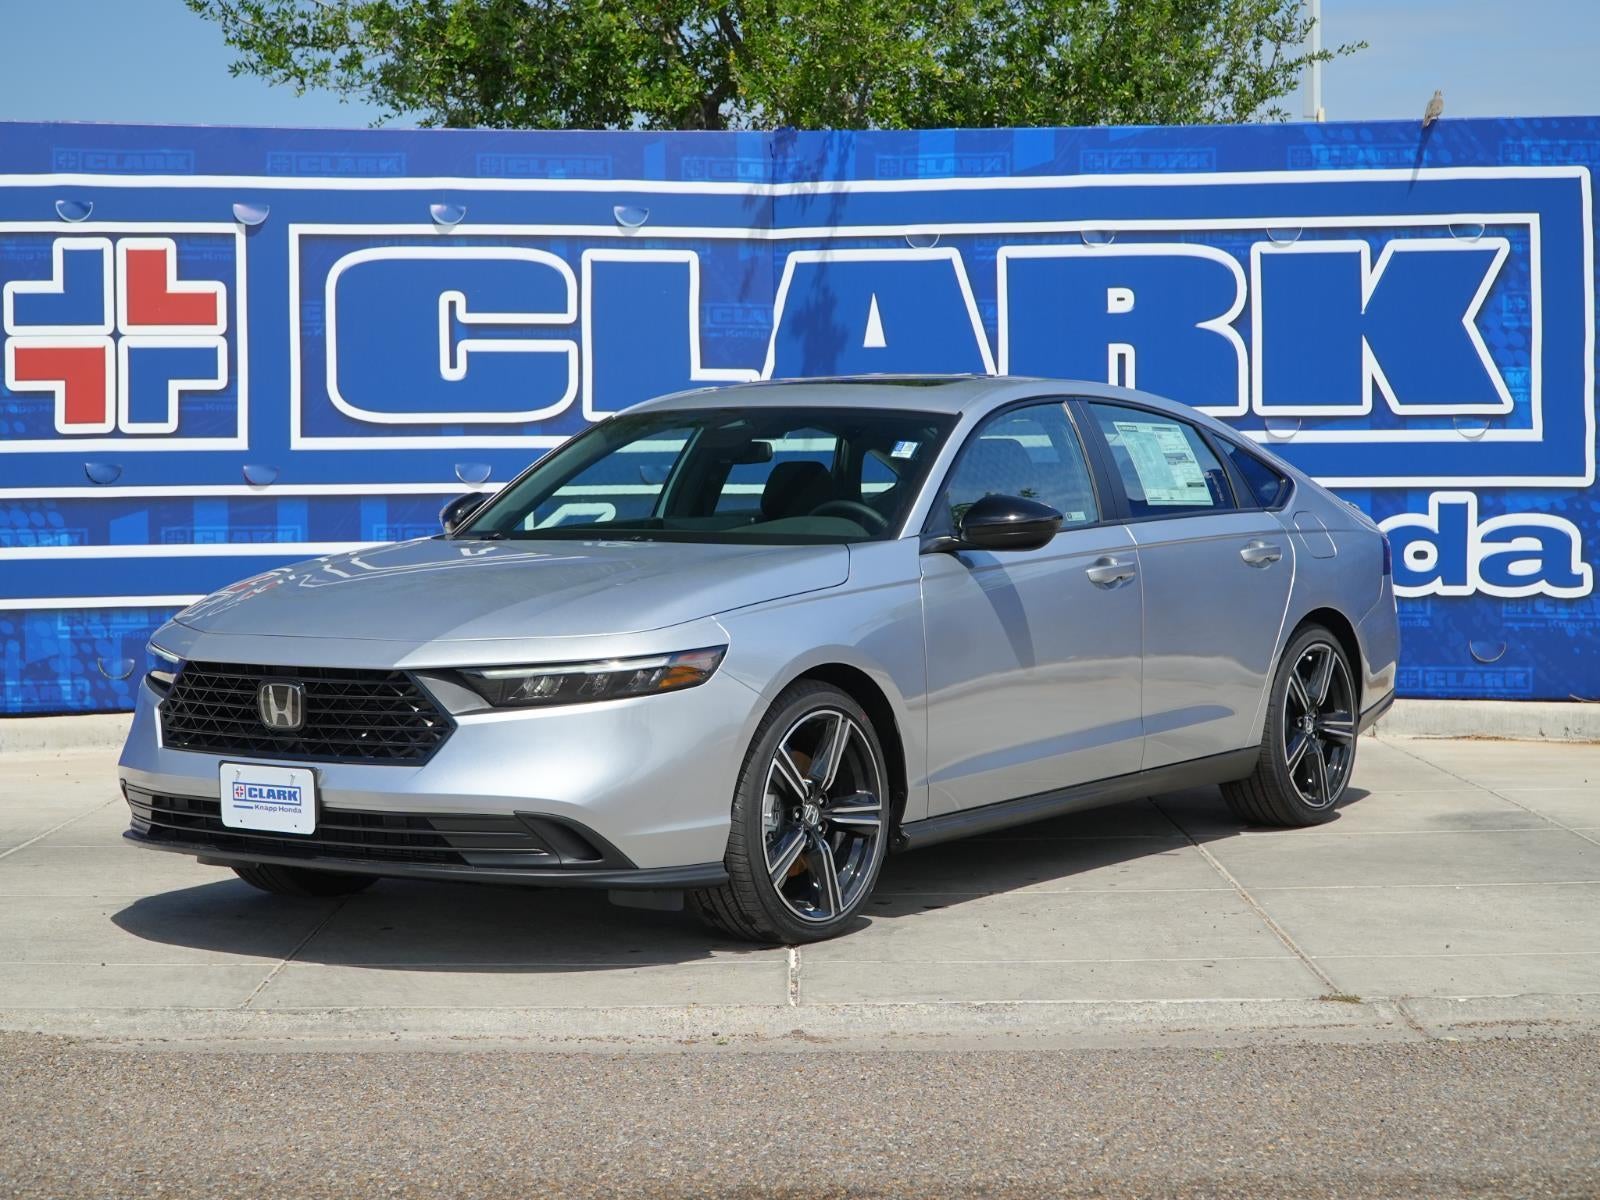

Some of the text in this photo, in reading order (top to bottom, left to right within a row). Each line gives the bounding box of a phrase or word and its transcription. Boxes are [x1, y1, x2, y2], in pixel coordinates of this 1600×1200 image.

[298, 156, 400, 173] CLARK
[505, 158, 607, 175] CLARK
[325, 237, 1514, 425] CLARK
[1425, 671, 1526, 687] CLARK
[247, 787, 299, 802] CLARK
[254, 804, 278, 813] Knapp
